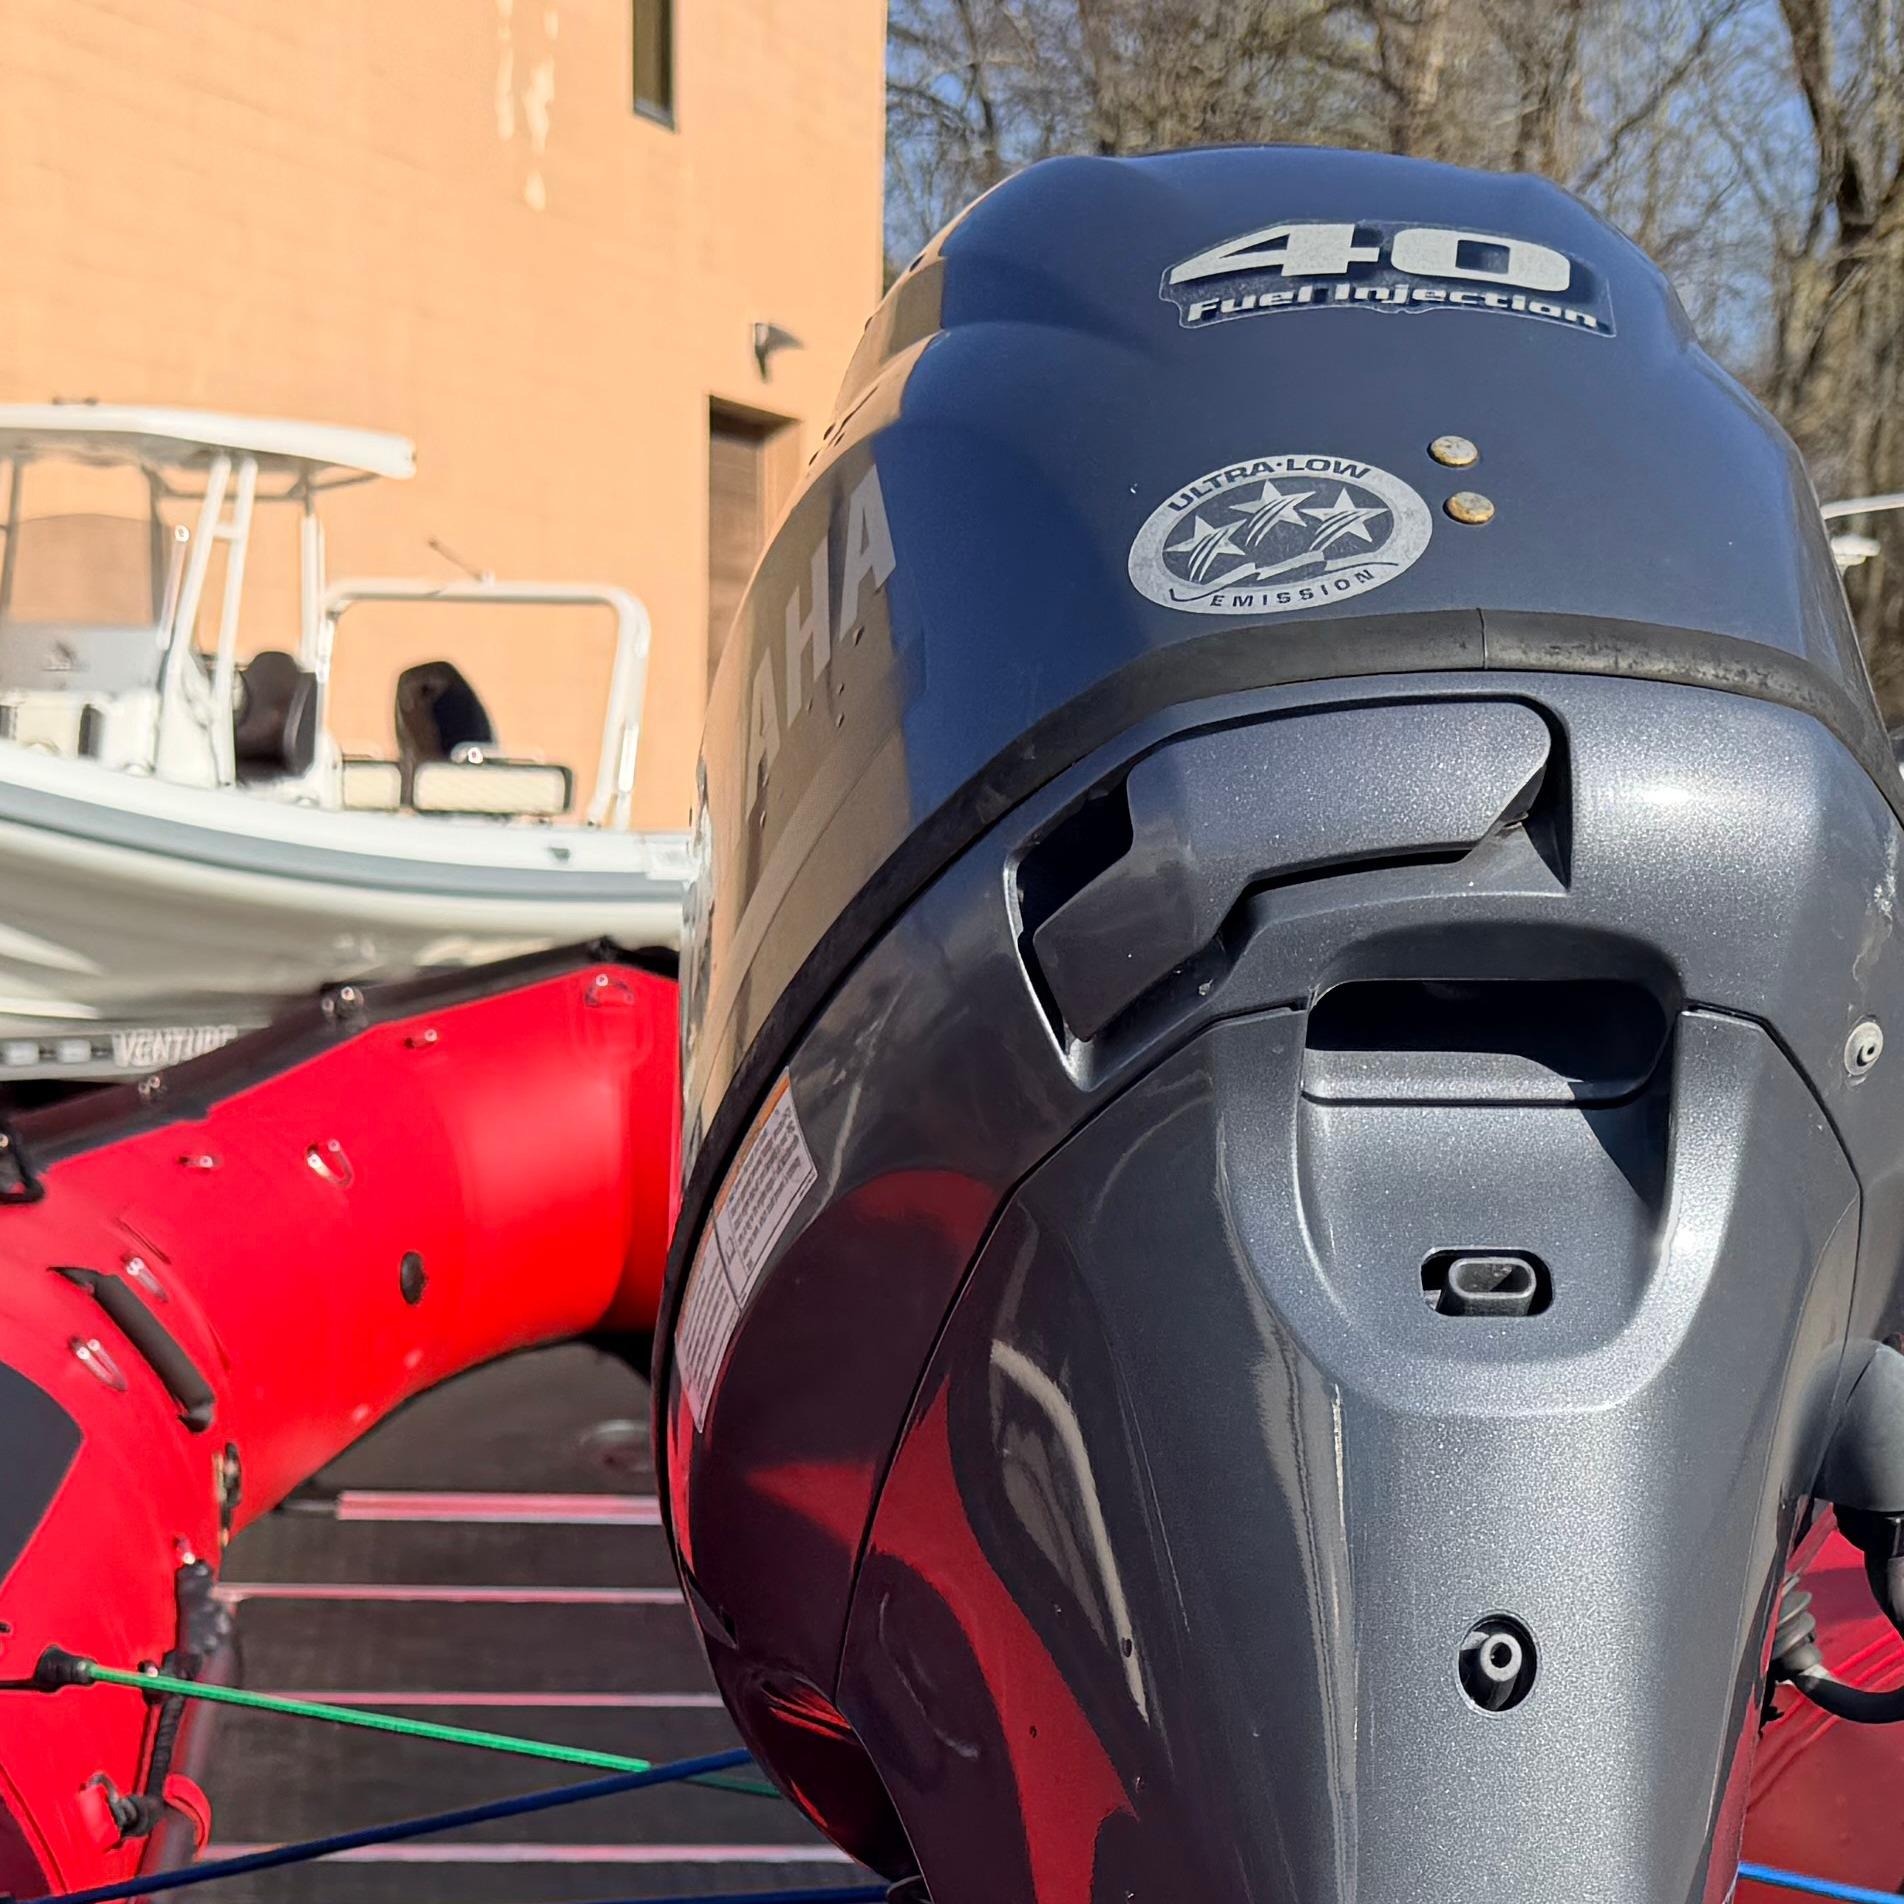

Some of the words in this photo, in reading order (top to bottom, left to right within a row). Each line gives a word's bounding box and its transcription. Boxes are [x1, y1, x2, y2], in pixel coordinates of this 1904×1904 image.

[1169, 223, 1571, 292] 40
[1187, 284, 1315, 322] Fuel
[1334, 283, 1598, 329] Injection
[1209, 568, 1375, 608] EMISSION
[745, 463, 897, 826] AHA
